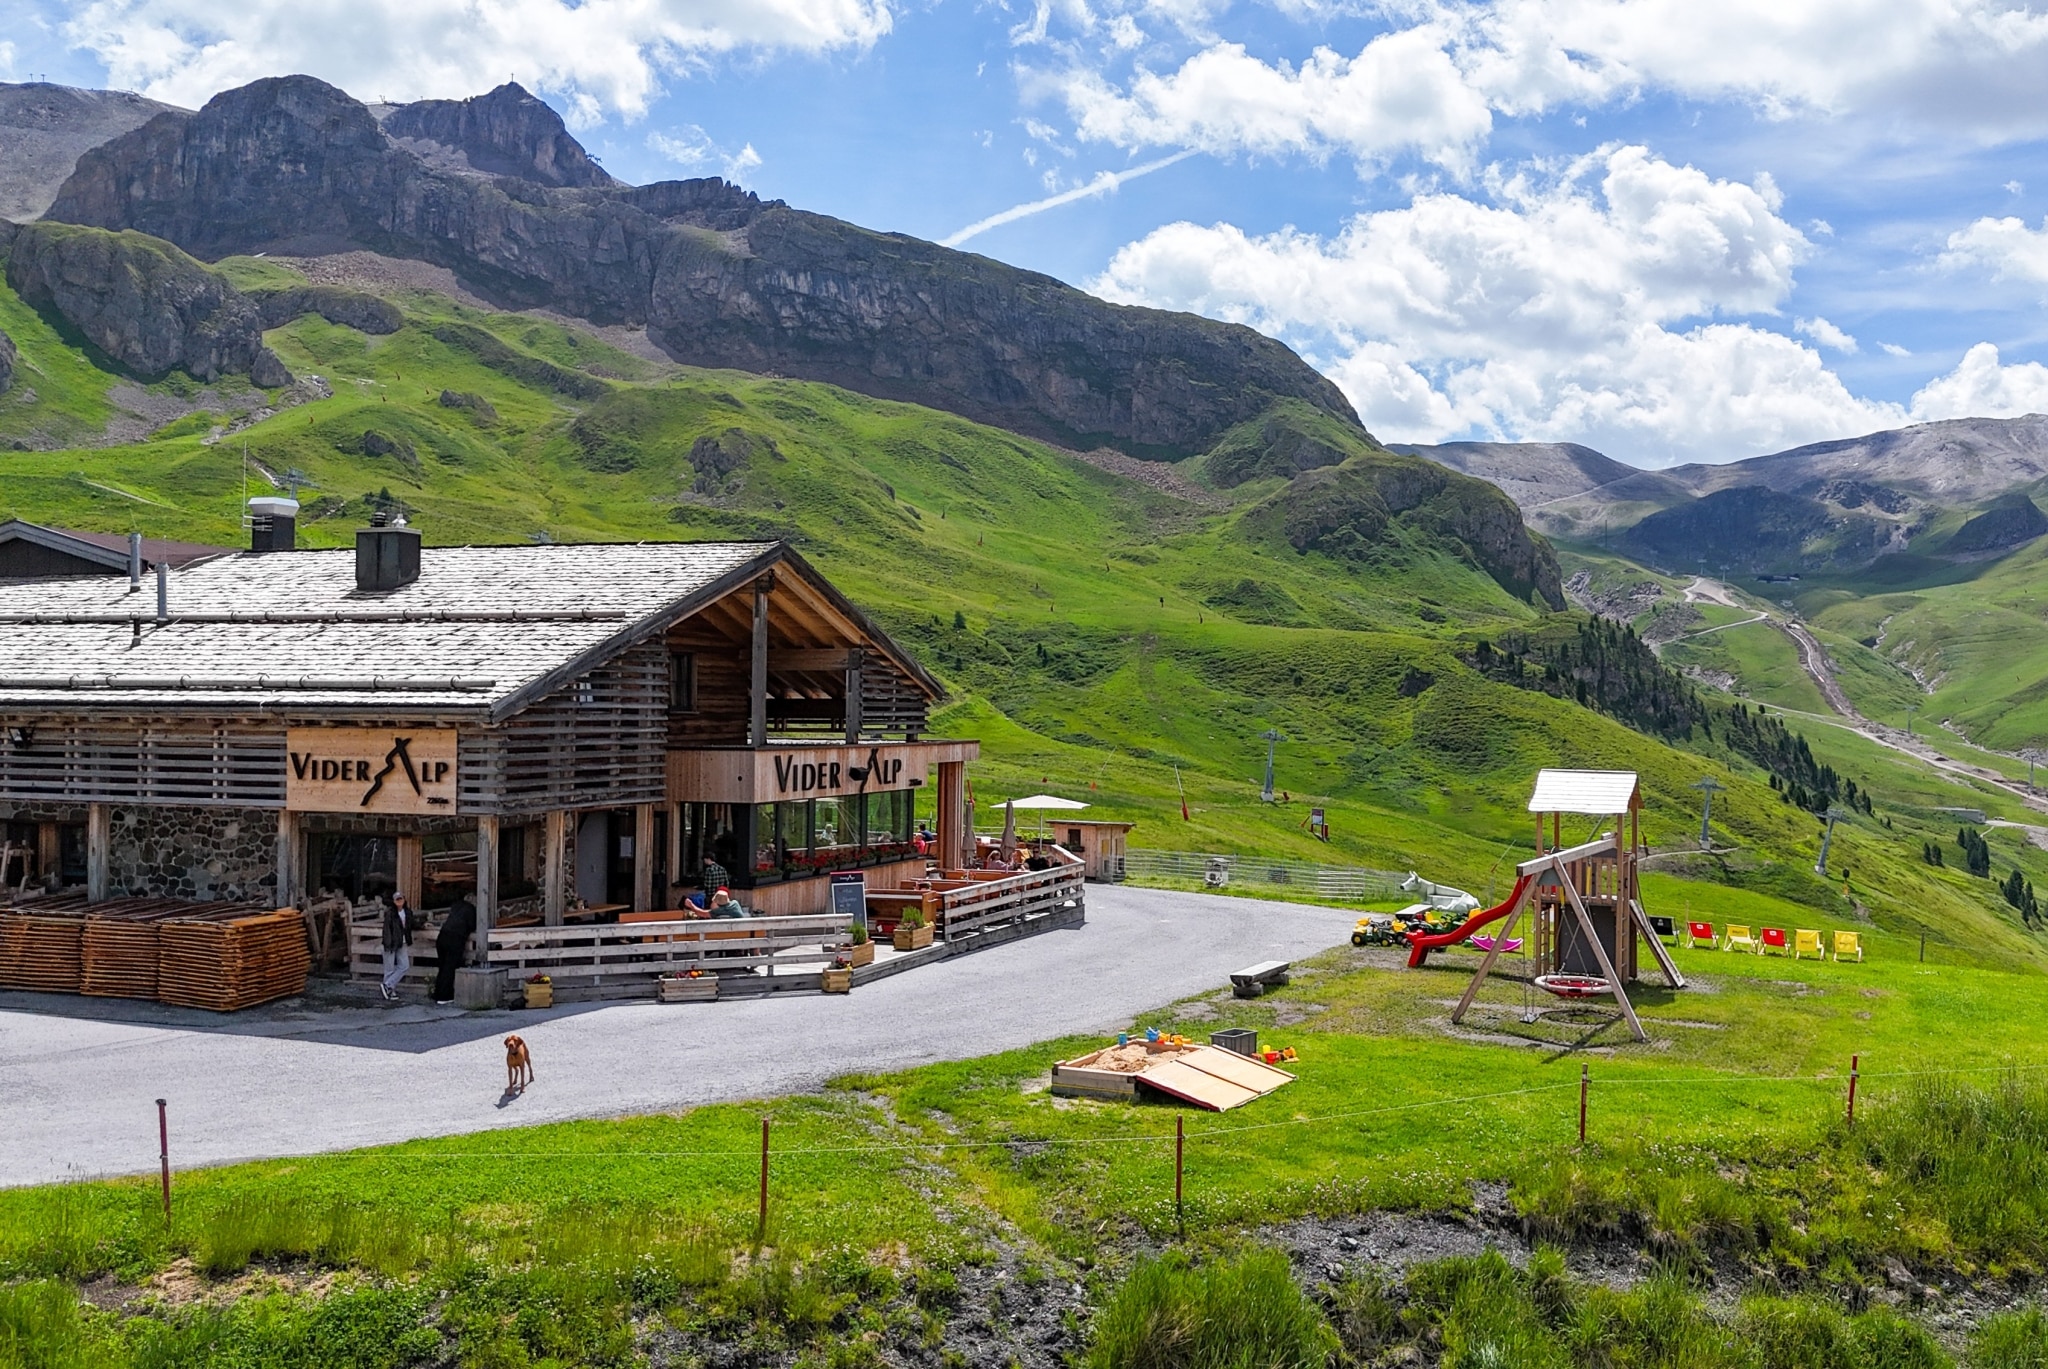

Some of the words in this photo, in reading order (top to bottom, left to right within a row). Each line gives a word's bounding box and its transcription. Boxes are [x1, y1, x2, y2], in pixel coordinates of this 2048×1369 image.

[290, 752, 370, 781] VIDER
[360, 737, 449, 806] ALP
[774, 754, 841, 793] VIDER
[860, 748, 902, 793] ALP
